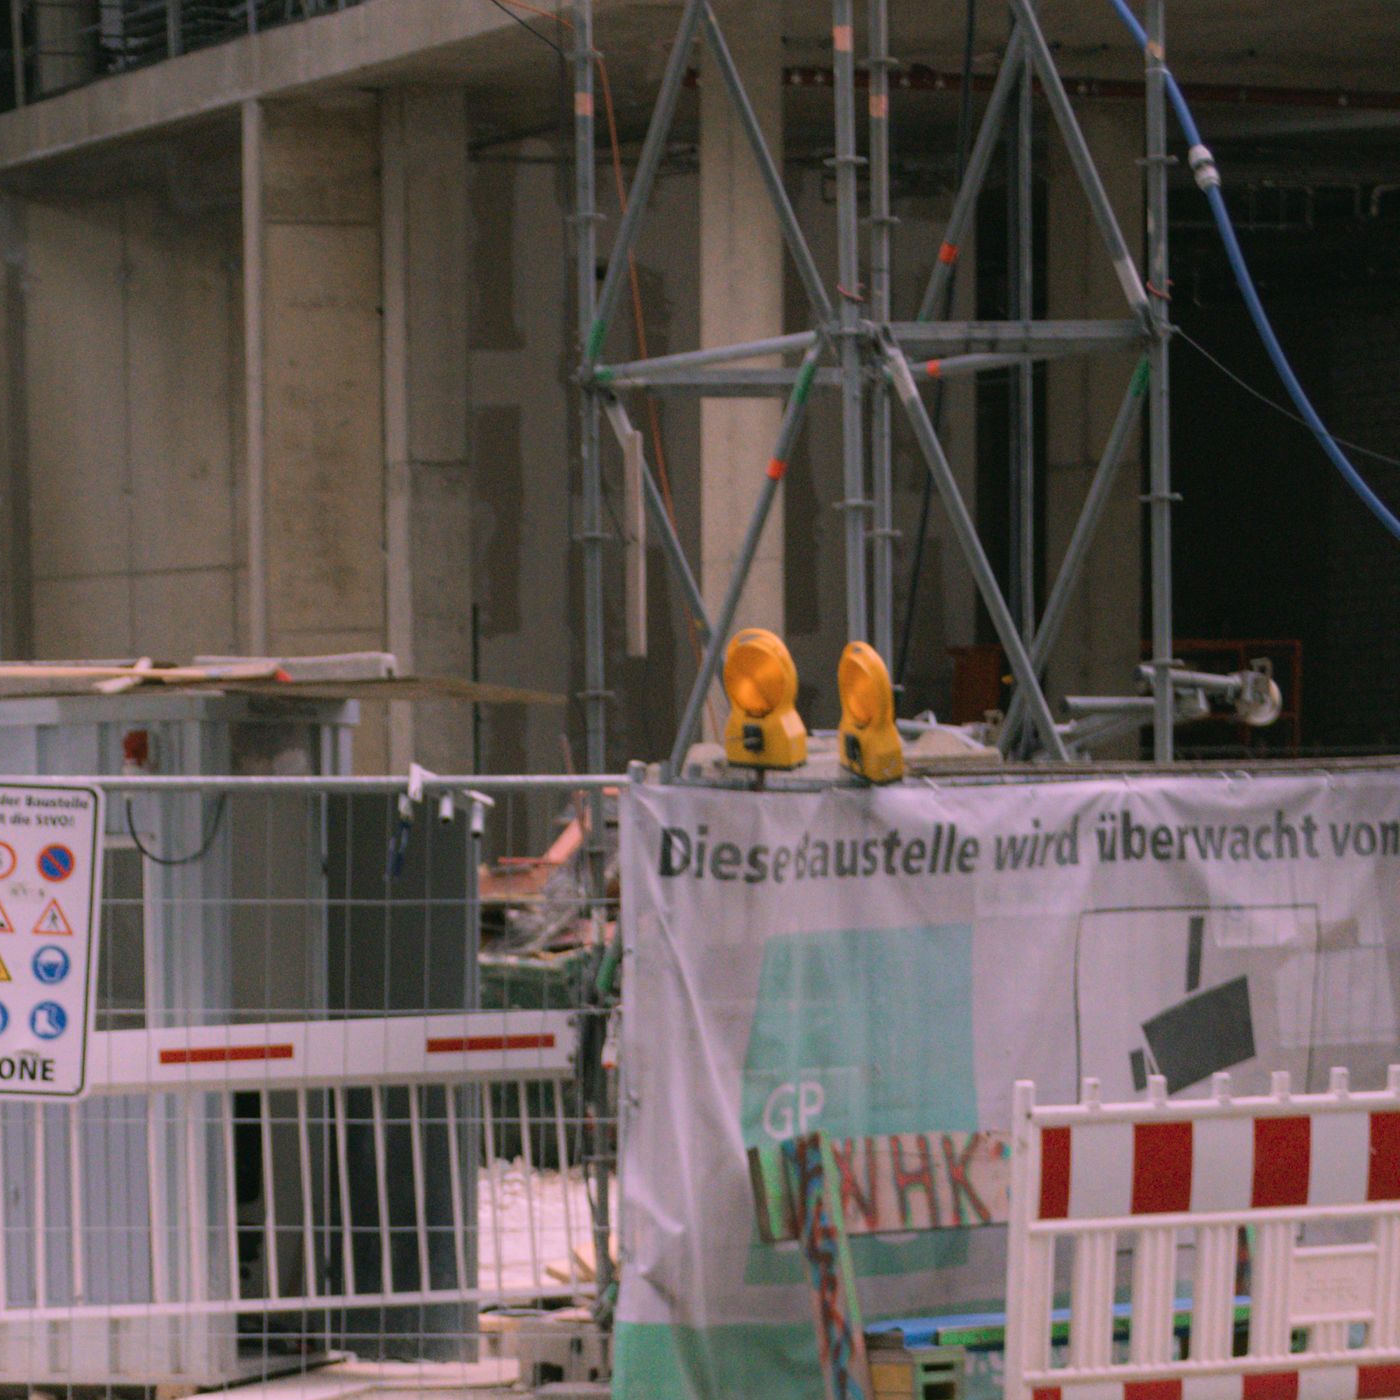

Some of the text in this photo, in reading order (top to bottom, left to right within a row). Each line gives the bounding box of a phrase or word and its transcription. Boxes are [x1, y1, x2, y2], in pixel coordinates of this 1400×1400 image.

[25, 795, 88, 809] Baustelle
[9, 812, 31, 825] die
[658, 824, 792, 884] Diese
[994, 815, 1079, 871] wird
[1095, 809, 1319, 862] überwacht
